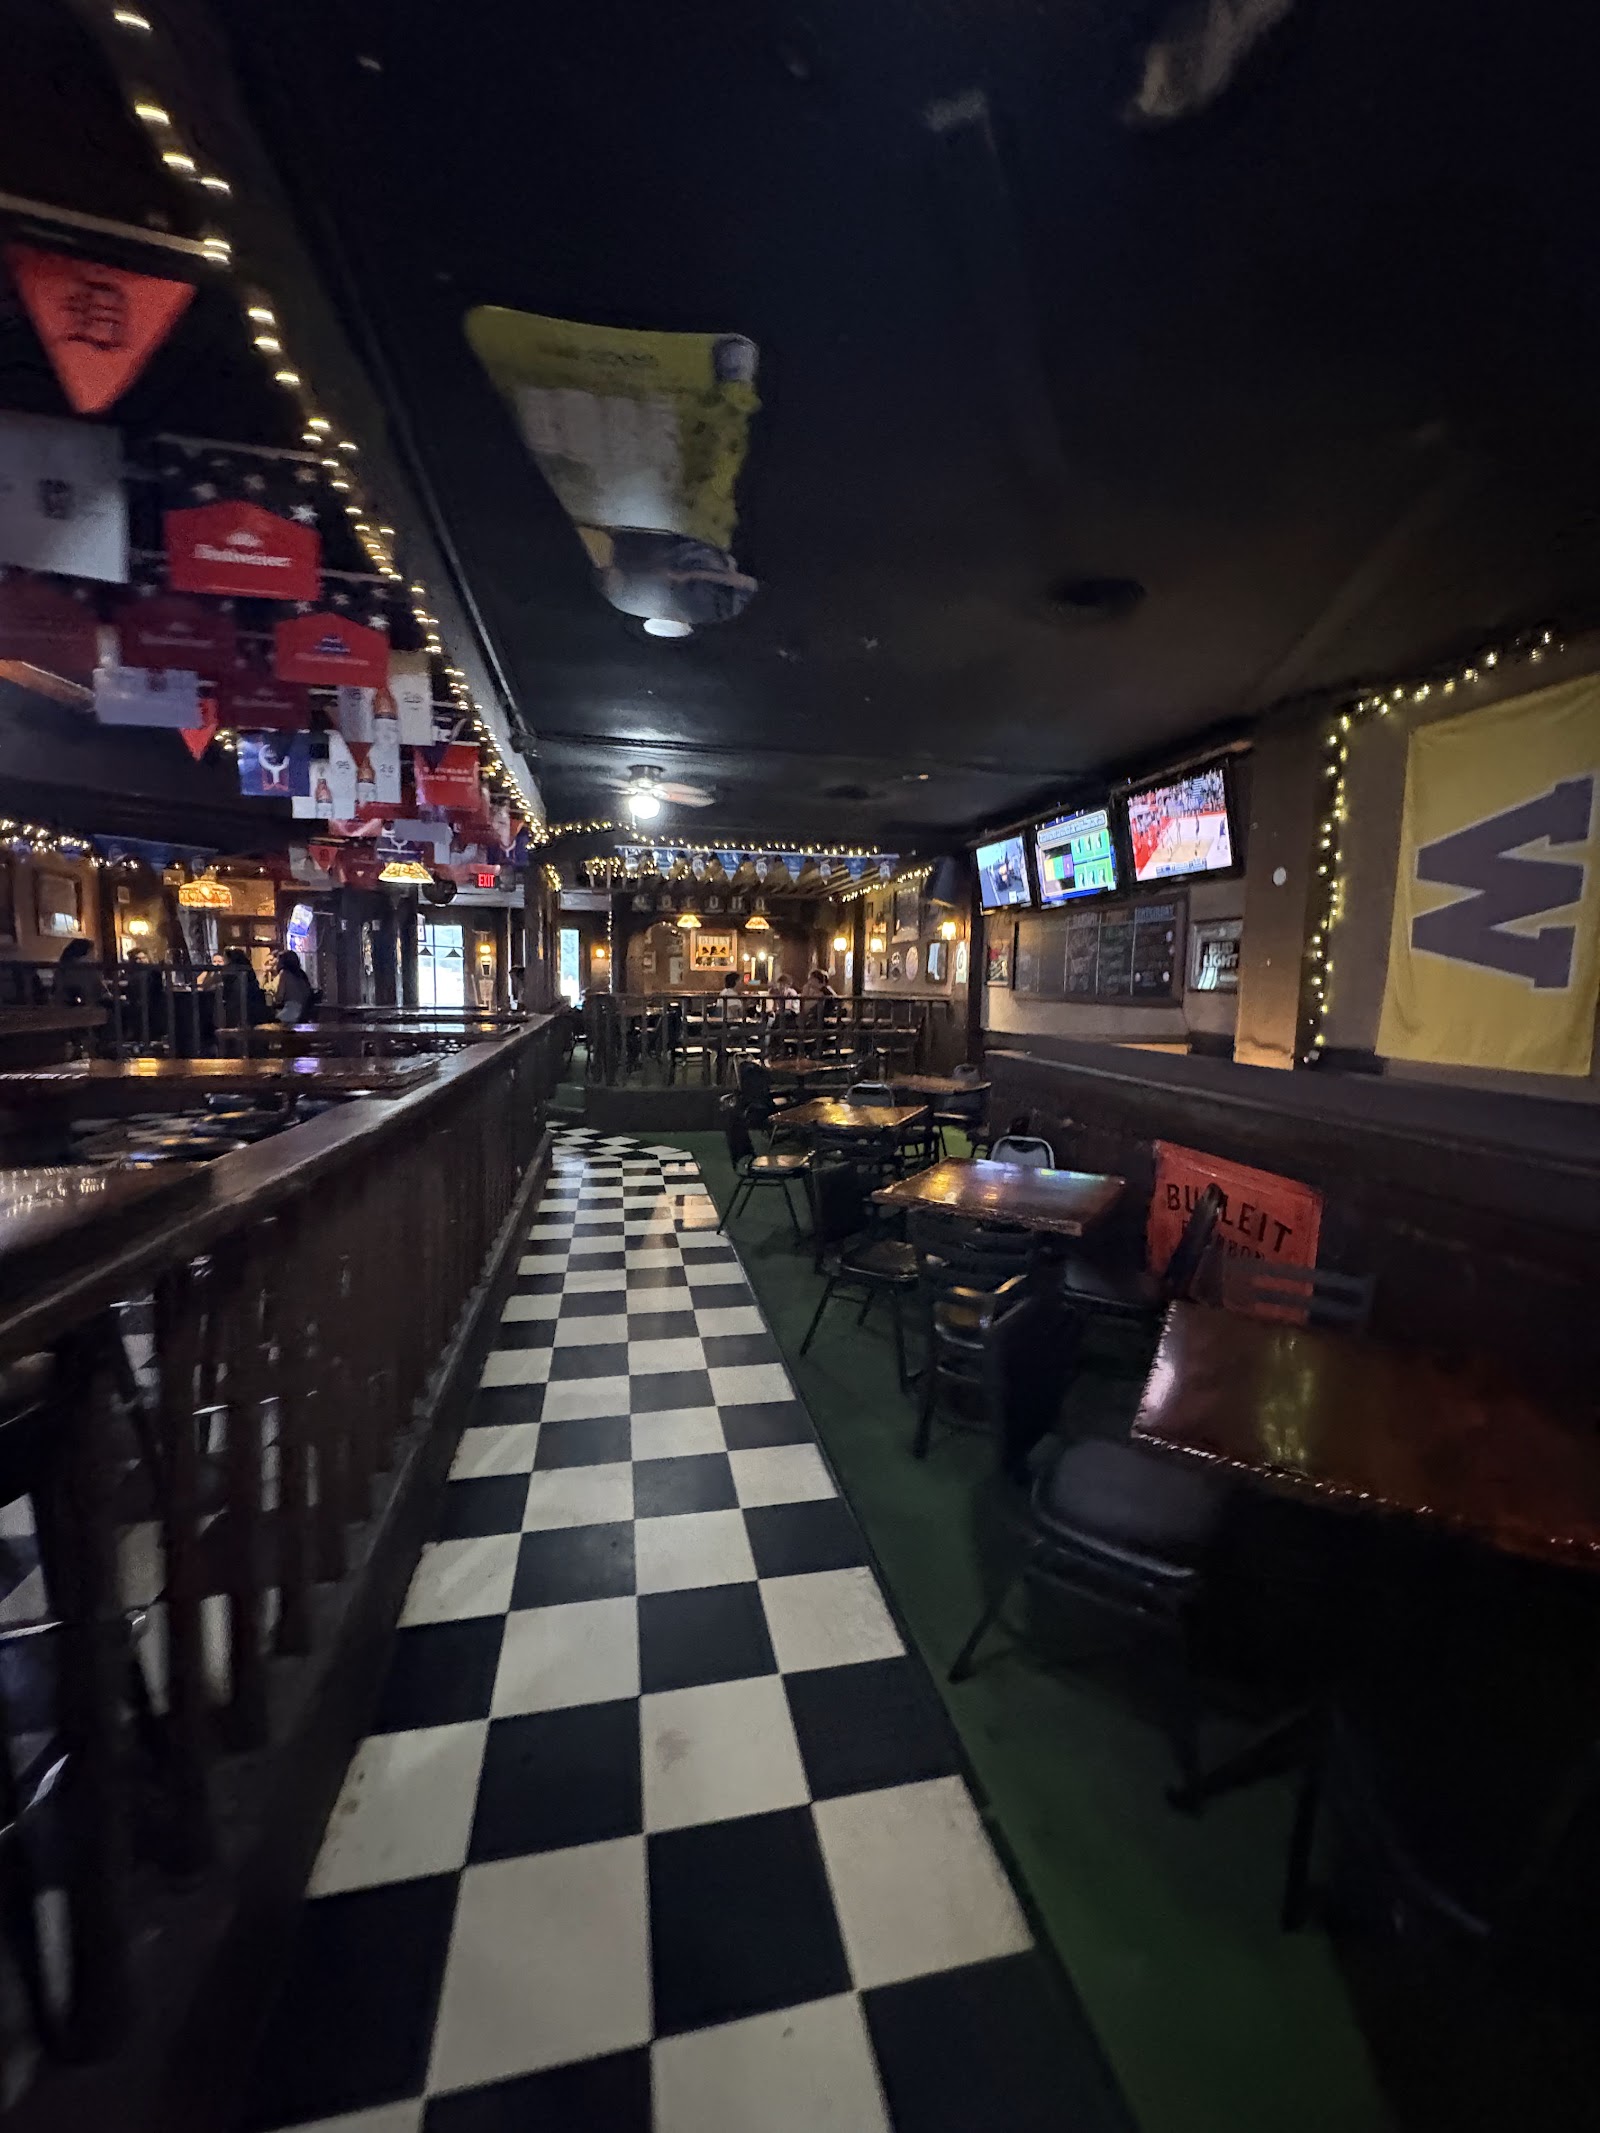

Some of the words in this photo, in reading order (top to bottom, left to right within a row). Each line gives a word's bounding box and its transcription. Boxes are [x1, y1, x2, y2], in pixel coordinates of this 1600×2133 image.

[478, 873, 495, 887] EXIT
[1410, 775, 1596, 991] W
[1209, 942, 1235, 954] BUD
[1203, 954, 1239, 968] LIGHT
[1167, 1184, 1292, 1252] BULEIT
